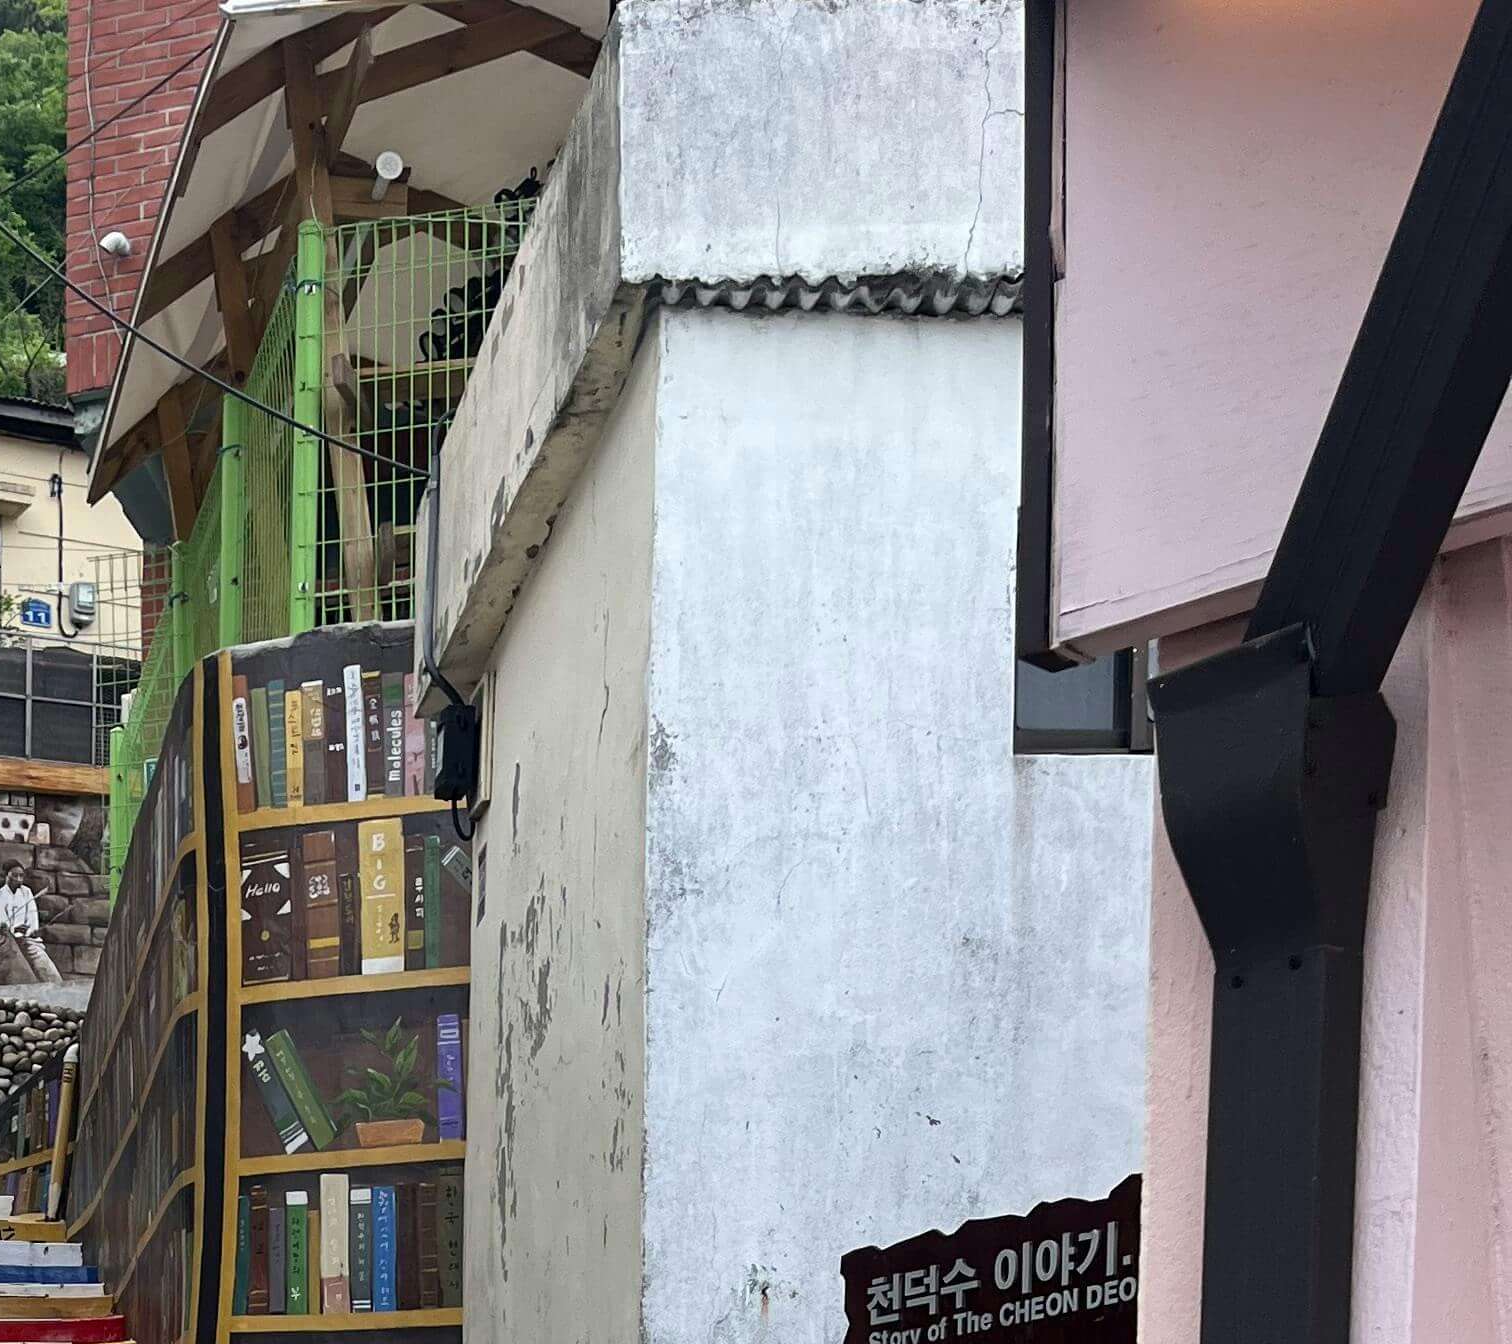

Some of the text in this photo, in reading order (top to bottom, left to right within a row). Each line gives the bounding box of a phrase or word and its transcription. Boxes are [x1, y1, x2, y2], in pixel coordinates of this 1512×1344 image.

[26, 611, 45, 624] 11
[866, 1257, 979, 1327] 천덕수
[927, 1320, 949, 1341] of
[955, 1311, 992, 1335] The
[998, 1289, 1080, 1328] CHEON
